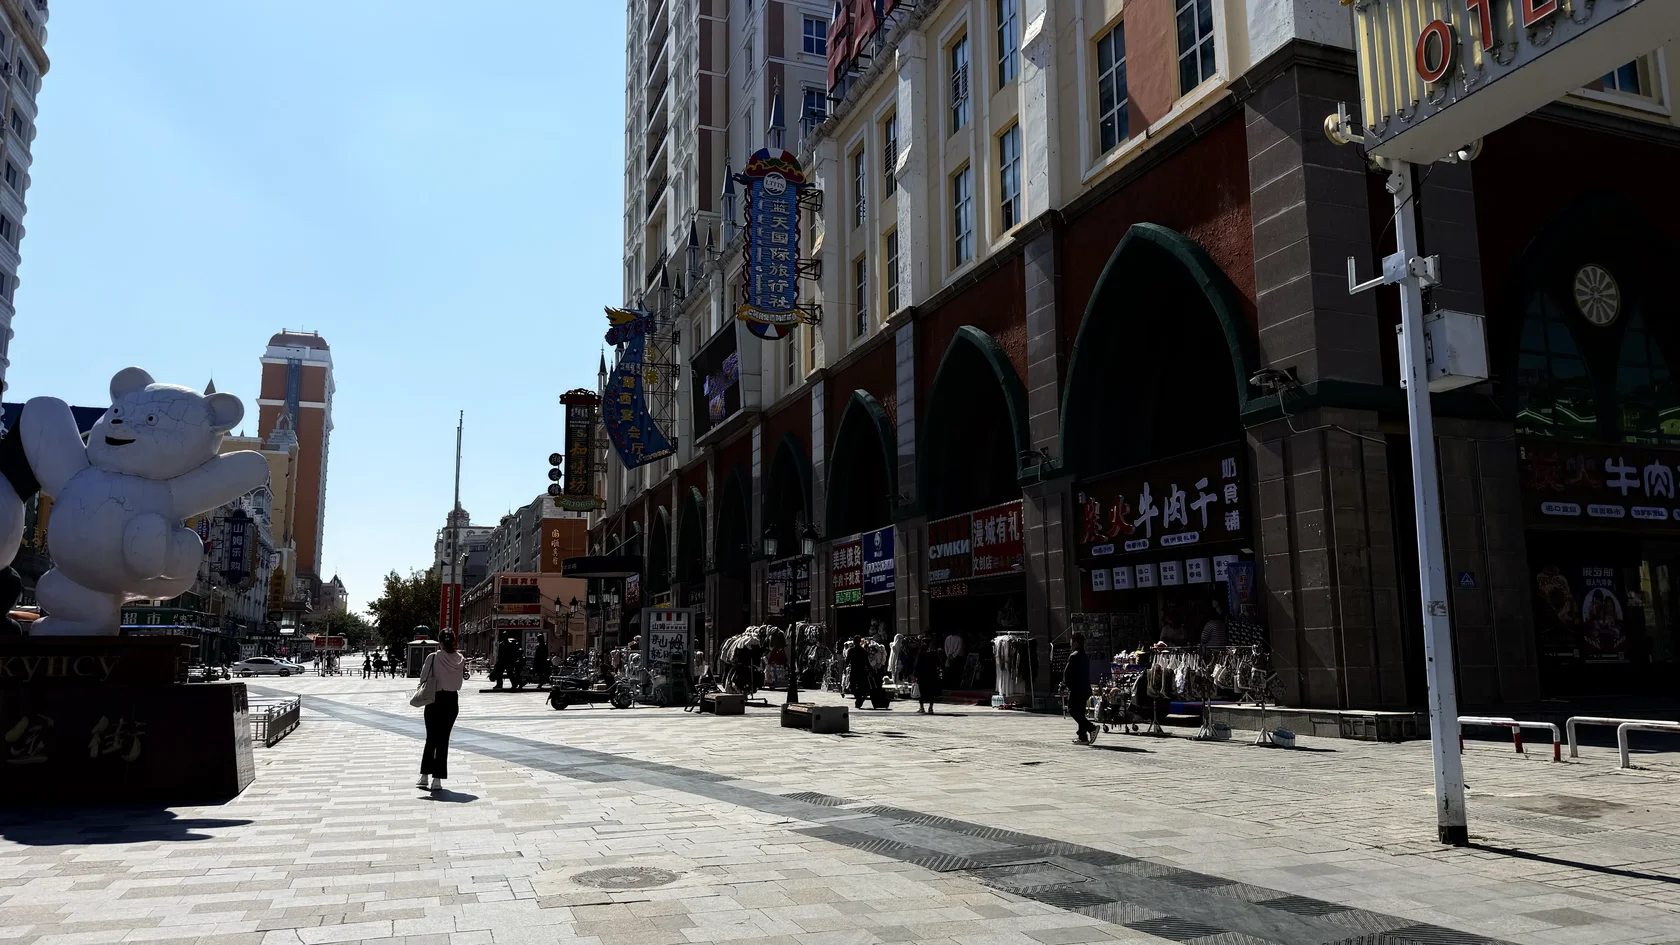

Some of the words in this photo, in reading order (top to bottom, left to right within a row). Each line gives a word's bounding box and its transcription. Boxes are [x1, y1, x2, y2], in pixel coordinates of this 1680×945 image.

[768, 199, 790, 309] 蓝天国际旅行社
[230, 523, 243, 571] 山姆乐购
[929, 539, 971, 560] СУМКИ
